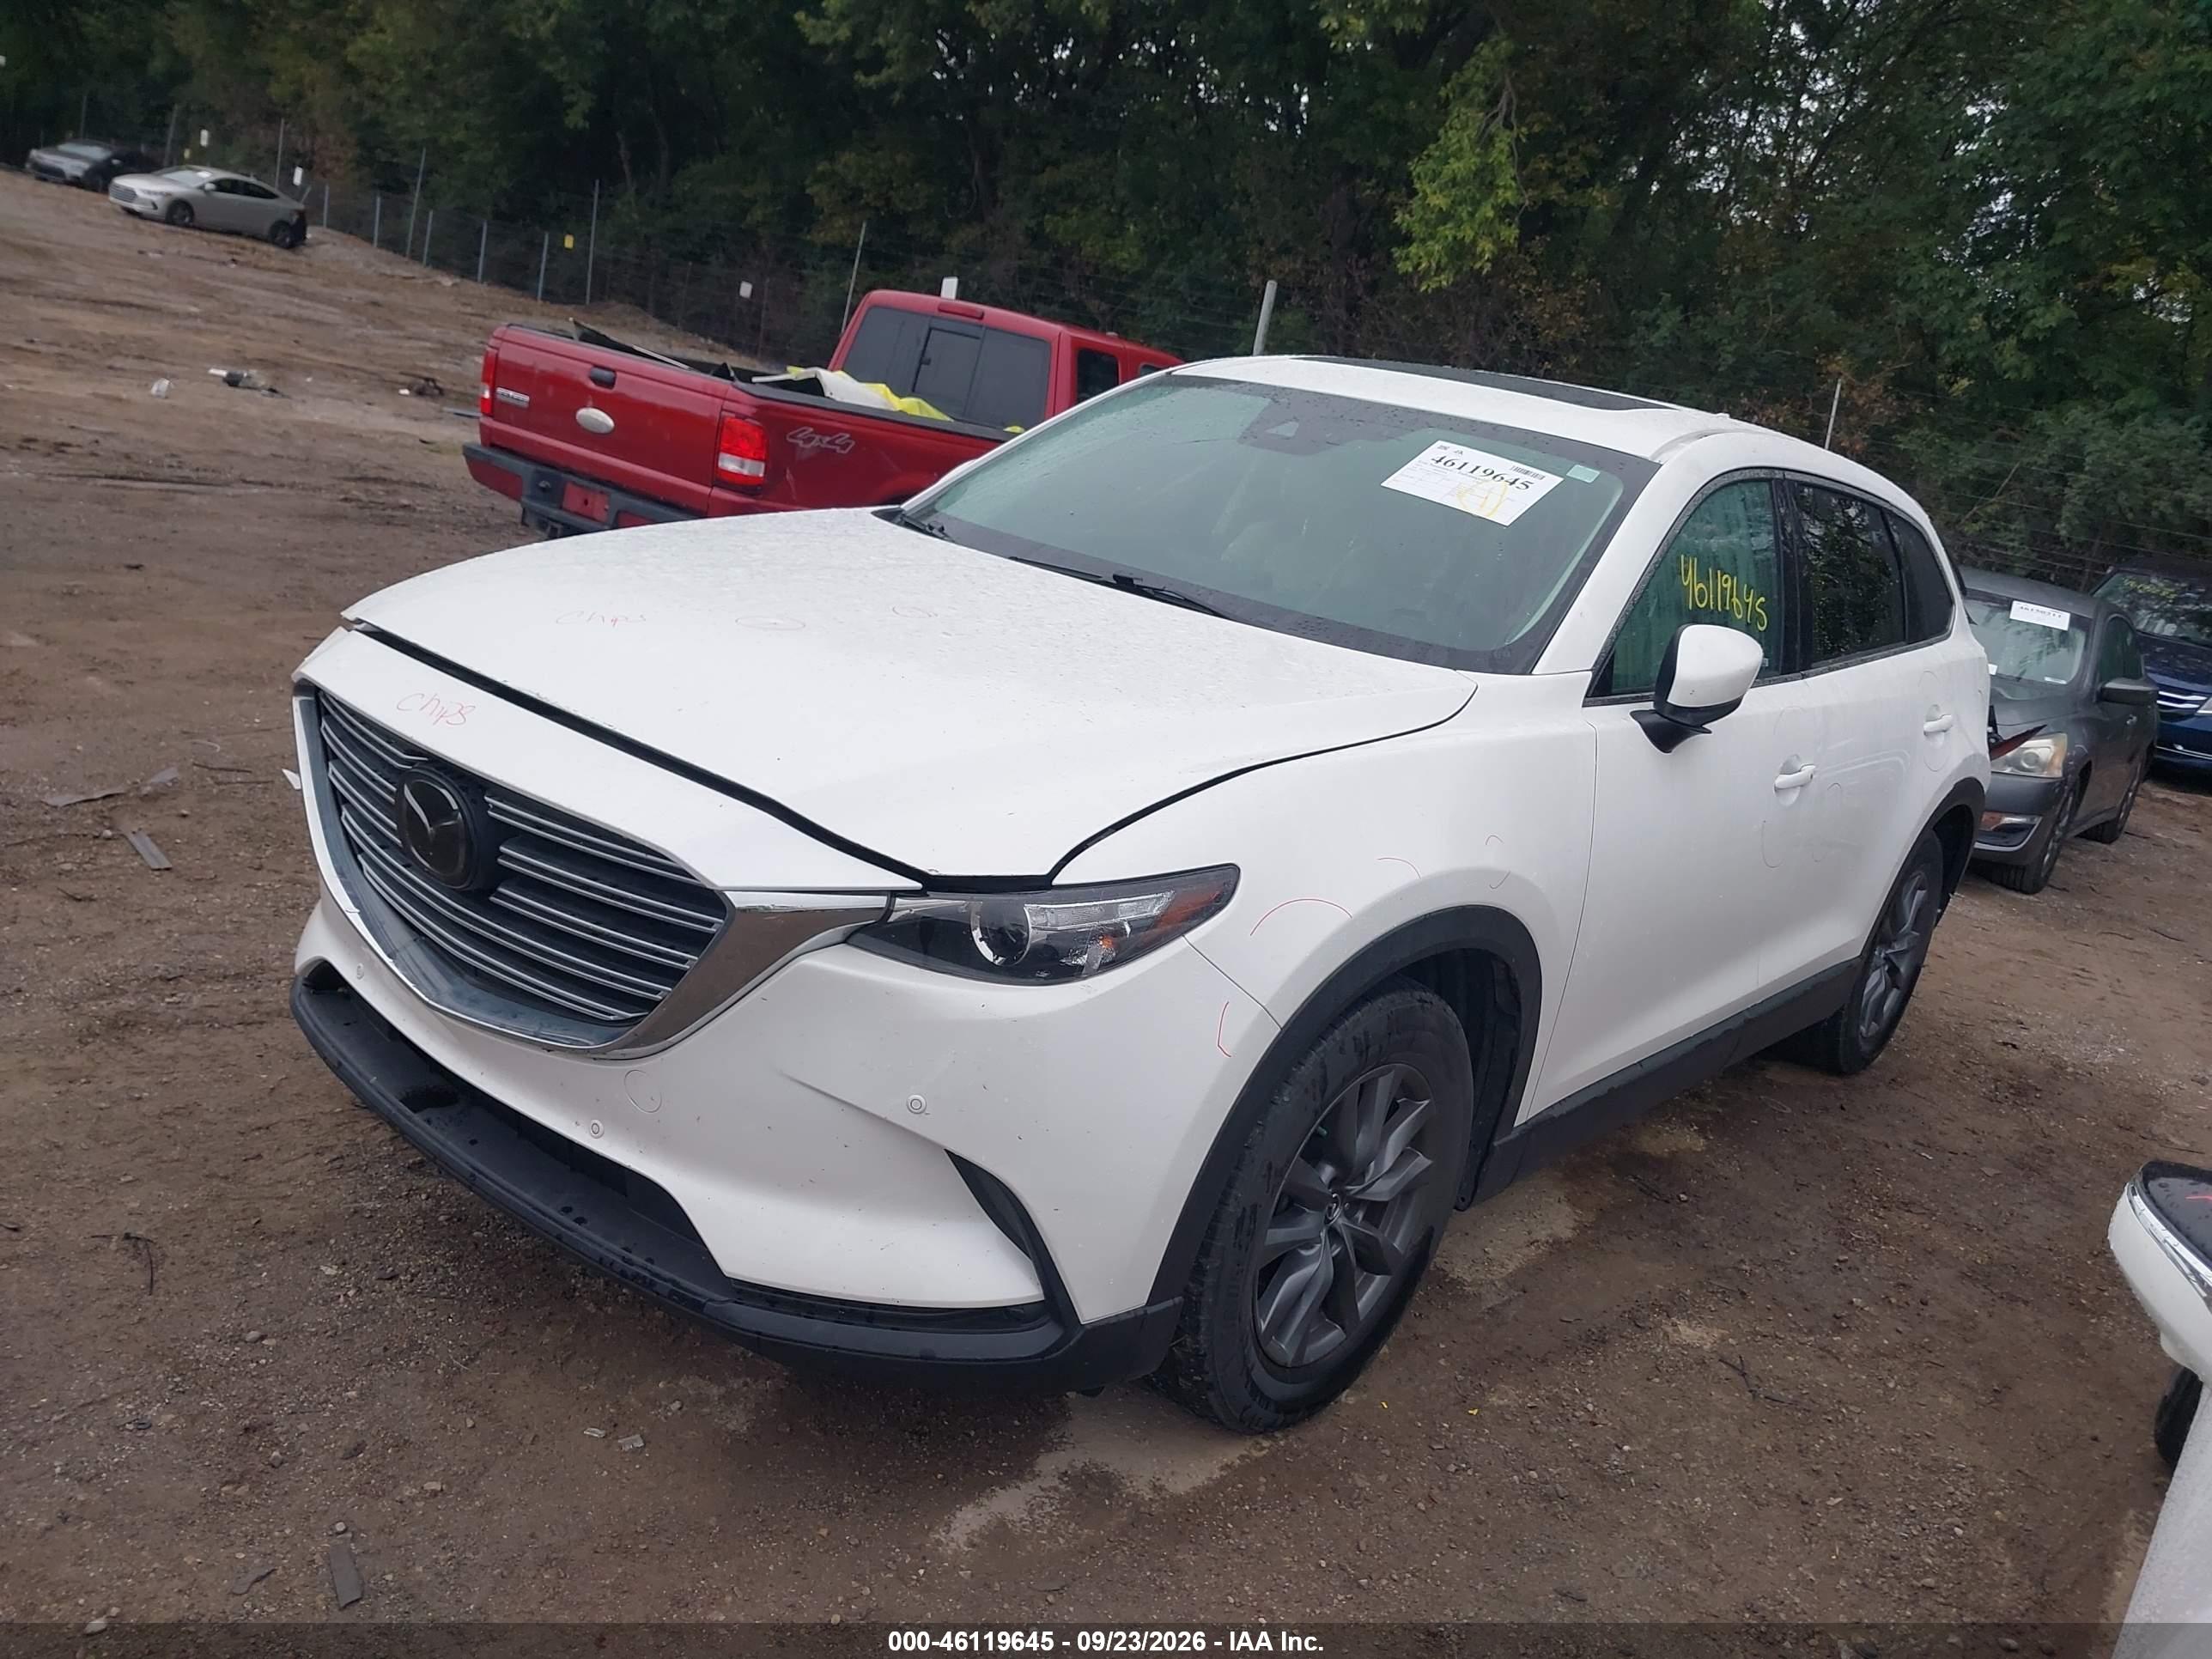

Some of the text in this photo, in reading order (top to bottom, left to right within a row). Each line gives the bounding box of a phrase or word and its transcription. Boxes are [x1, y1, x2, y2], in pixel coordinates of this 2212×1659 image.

[786, 426, 856, 453] 4x4
[1431, 455, 1534, 490] 46119645
[1680, 554, 1768, 631] 46119645
